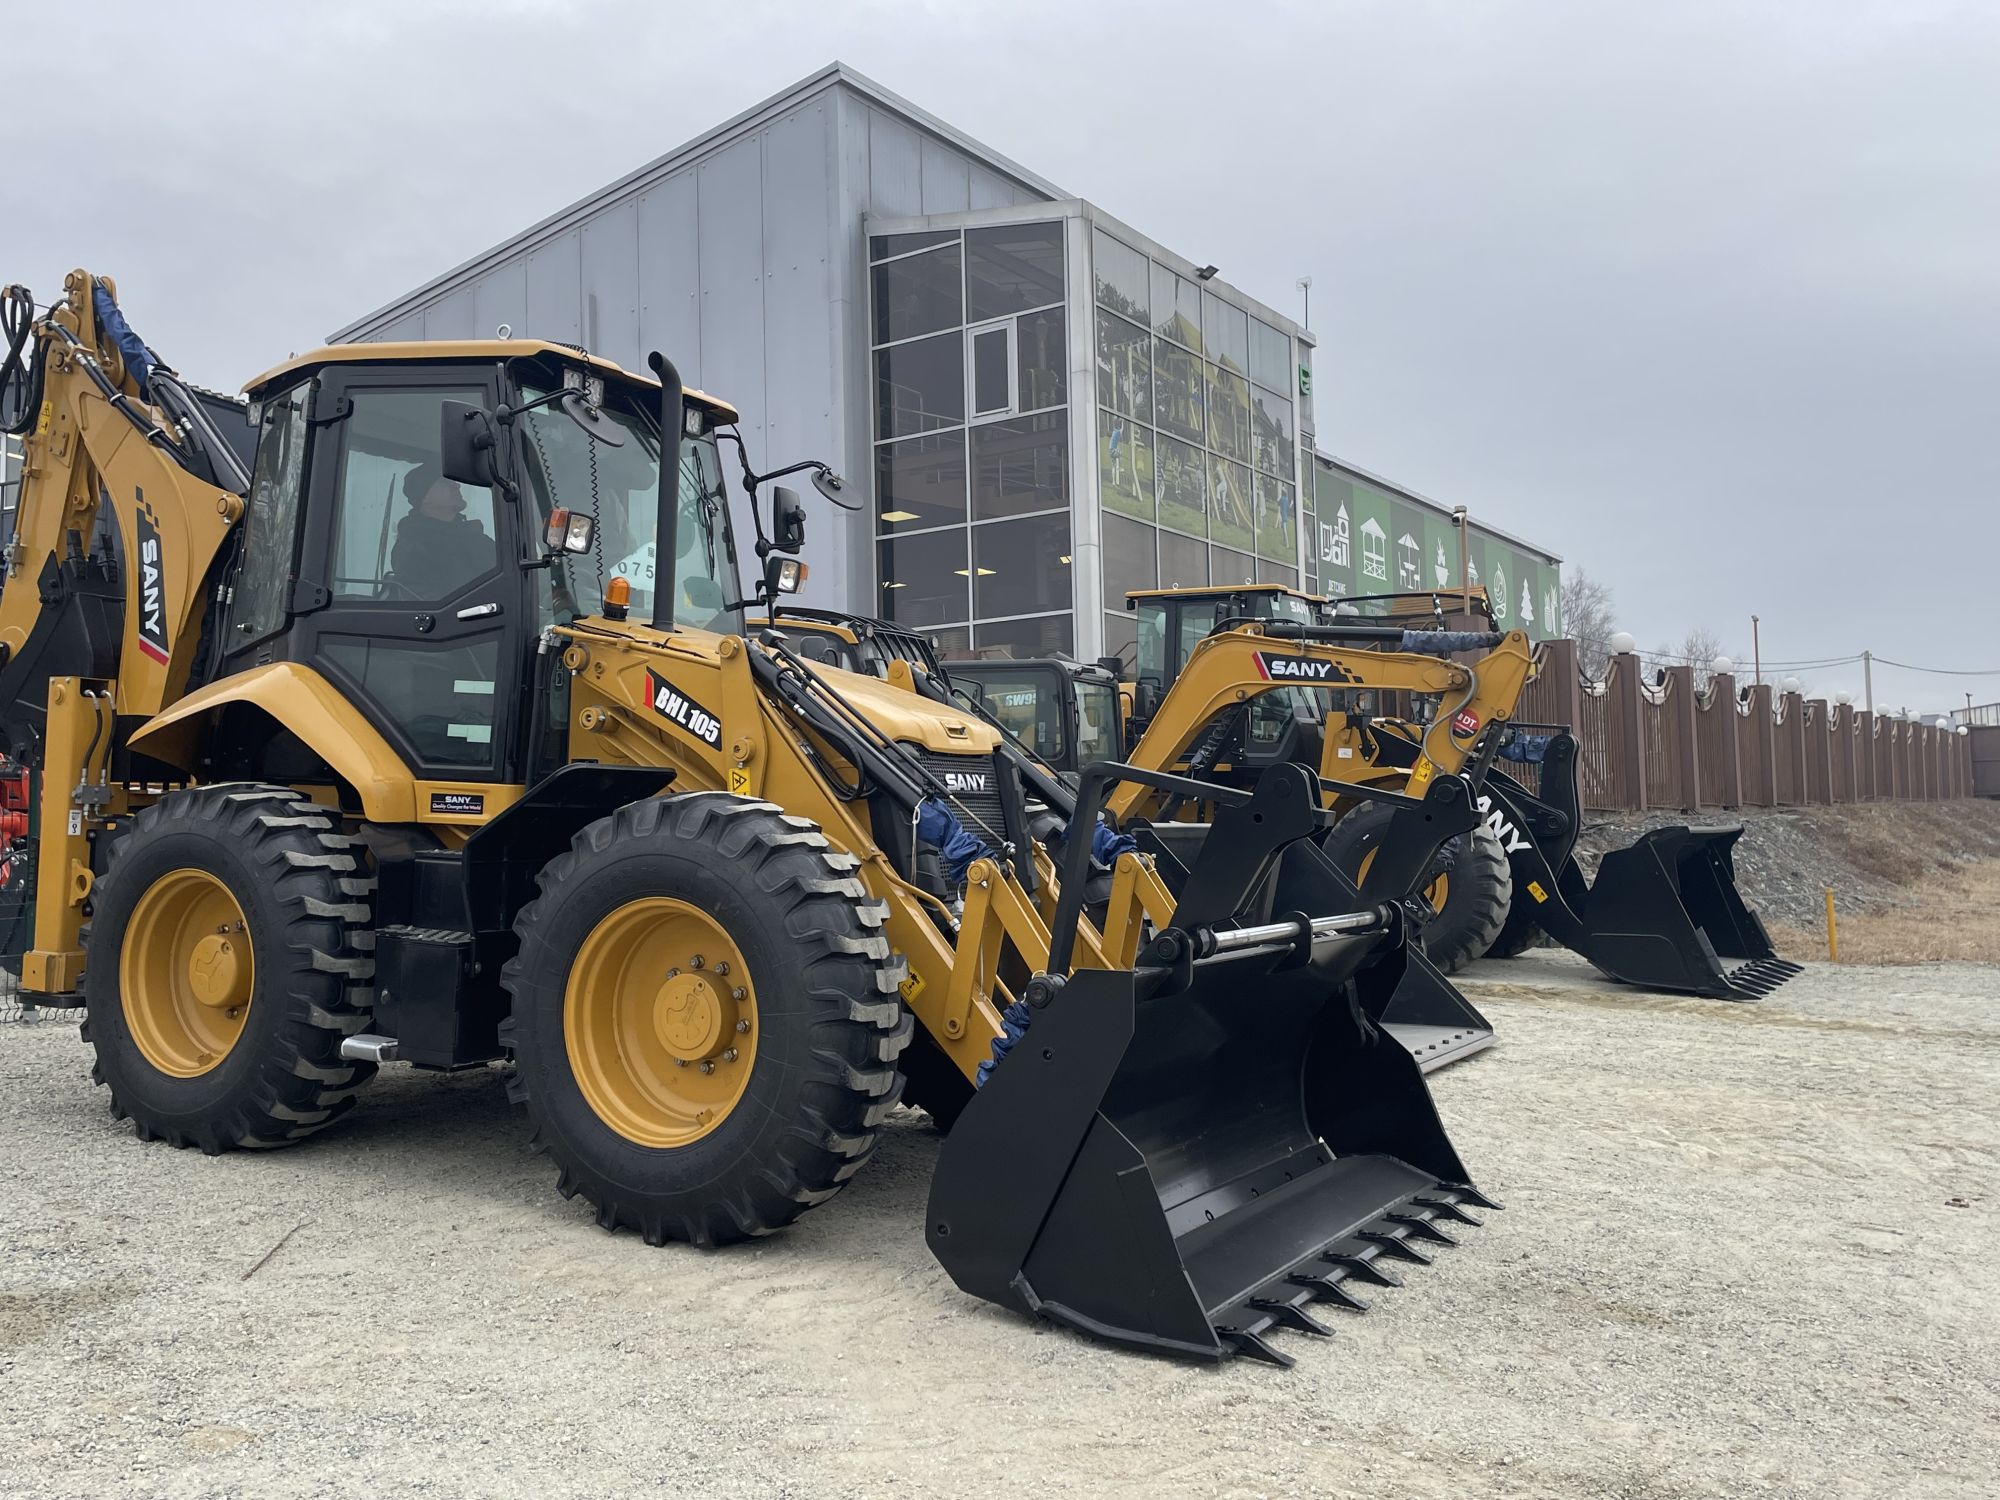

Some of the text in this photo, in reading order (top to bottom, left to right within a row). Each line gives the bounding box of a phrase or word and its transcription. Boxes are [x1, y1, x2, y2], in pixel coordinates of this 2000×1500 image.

[142, 538, 161, 636] SANY
[1271, 660, 1332, 678] SANY
[945, 773, 985, 791] SANY
[445, 795, 471, 804] SANY
[1460, 773, 1533, 854] ANY
